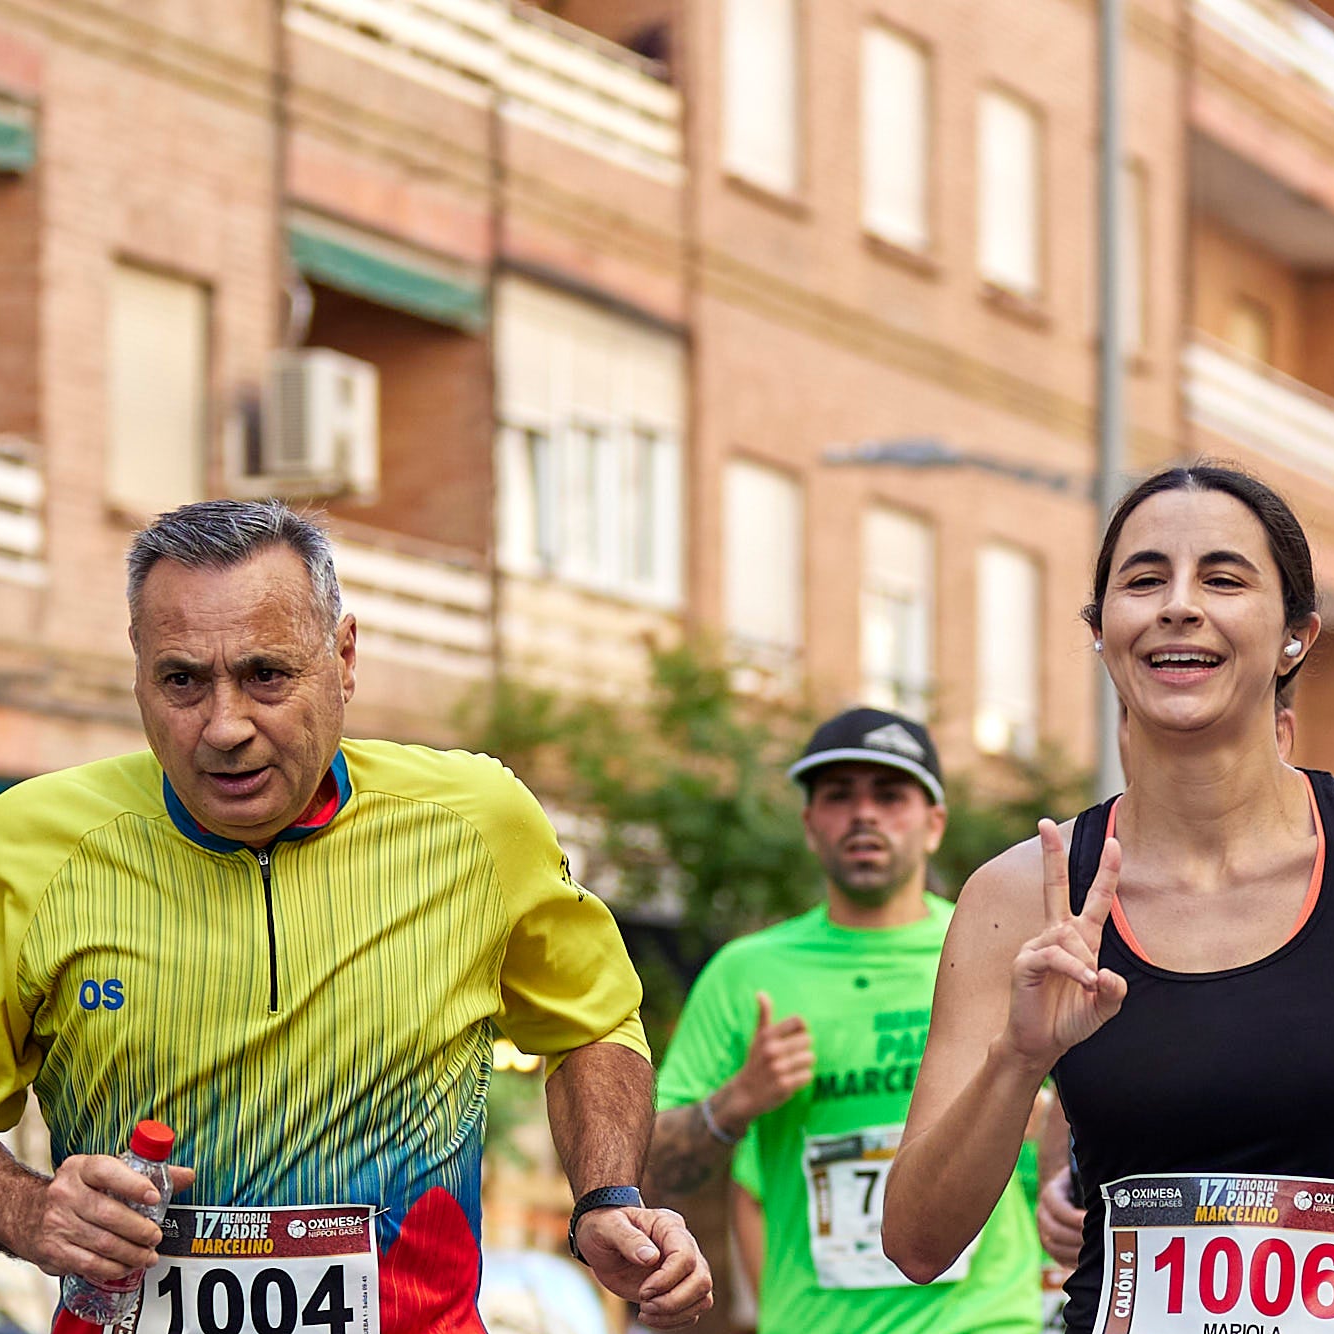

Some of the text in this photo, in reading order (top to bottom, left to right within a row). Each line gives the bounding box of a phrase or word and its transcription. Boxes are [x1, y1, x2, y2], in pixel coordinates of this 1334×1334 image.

[80, 979, 124, 1010] OS
[1131, 1188, 1183, 1199] OXIMESA
[1199, 1178, 1227, 1207] 17
[1226, 1179, 1279, 1192] MEMORIAL
[1131, 1199, 1183, 1208] NIPPON GASES
[1227, 1191, 1275, 1208] PADRE
[220, 1212, 272, 1224] MEMORIAL
[1194, 1206, 1280, 1223] MARCELINO
[195, 1211, 221, 1239] 17
[221, 1223, 269, 1239] PADRE
[308, 1216, 363, 1230] OXIMESA
[308, 1227, 364, 1238] NIPPON GASES
[190, 1238, 275, 1255] MARCELINO
[1114, 1251, 1134, 1318] CAJÓN 4
